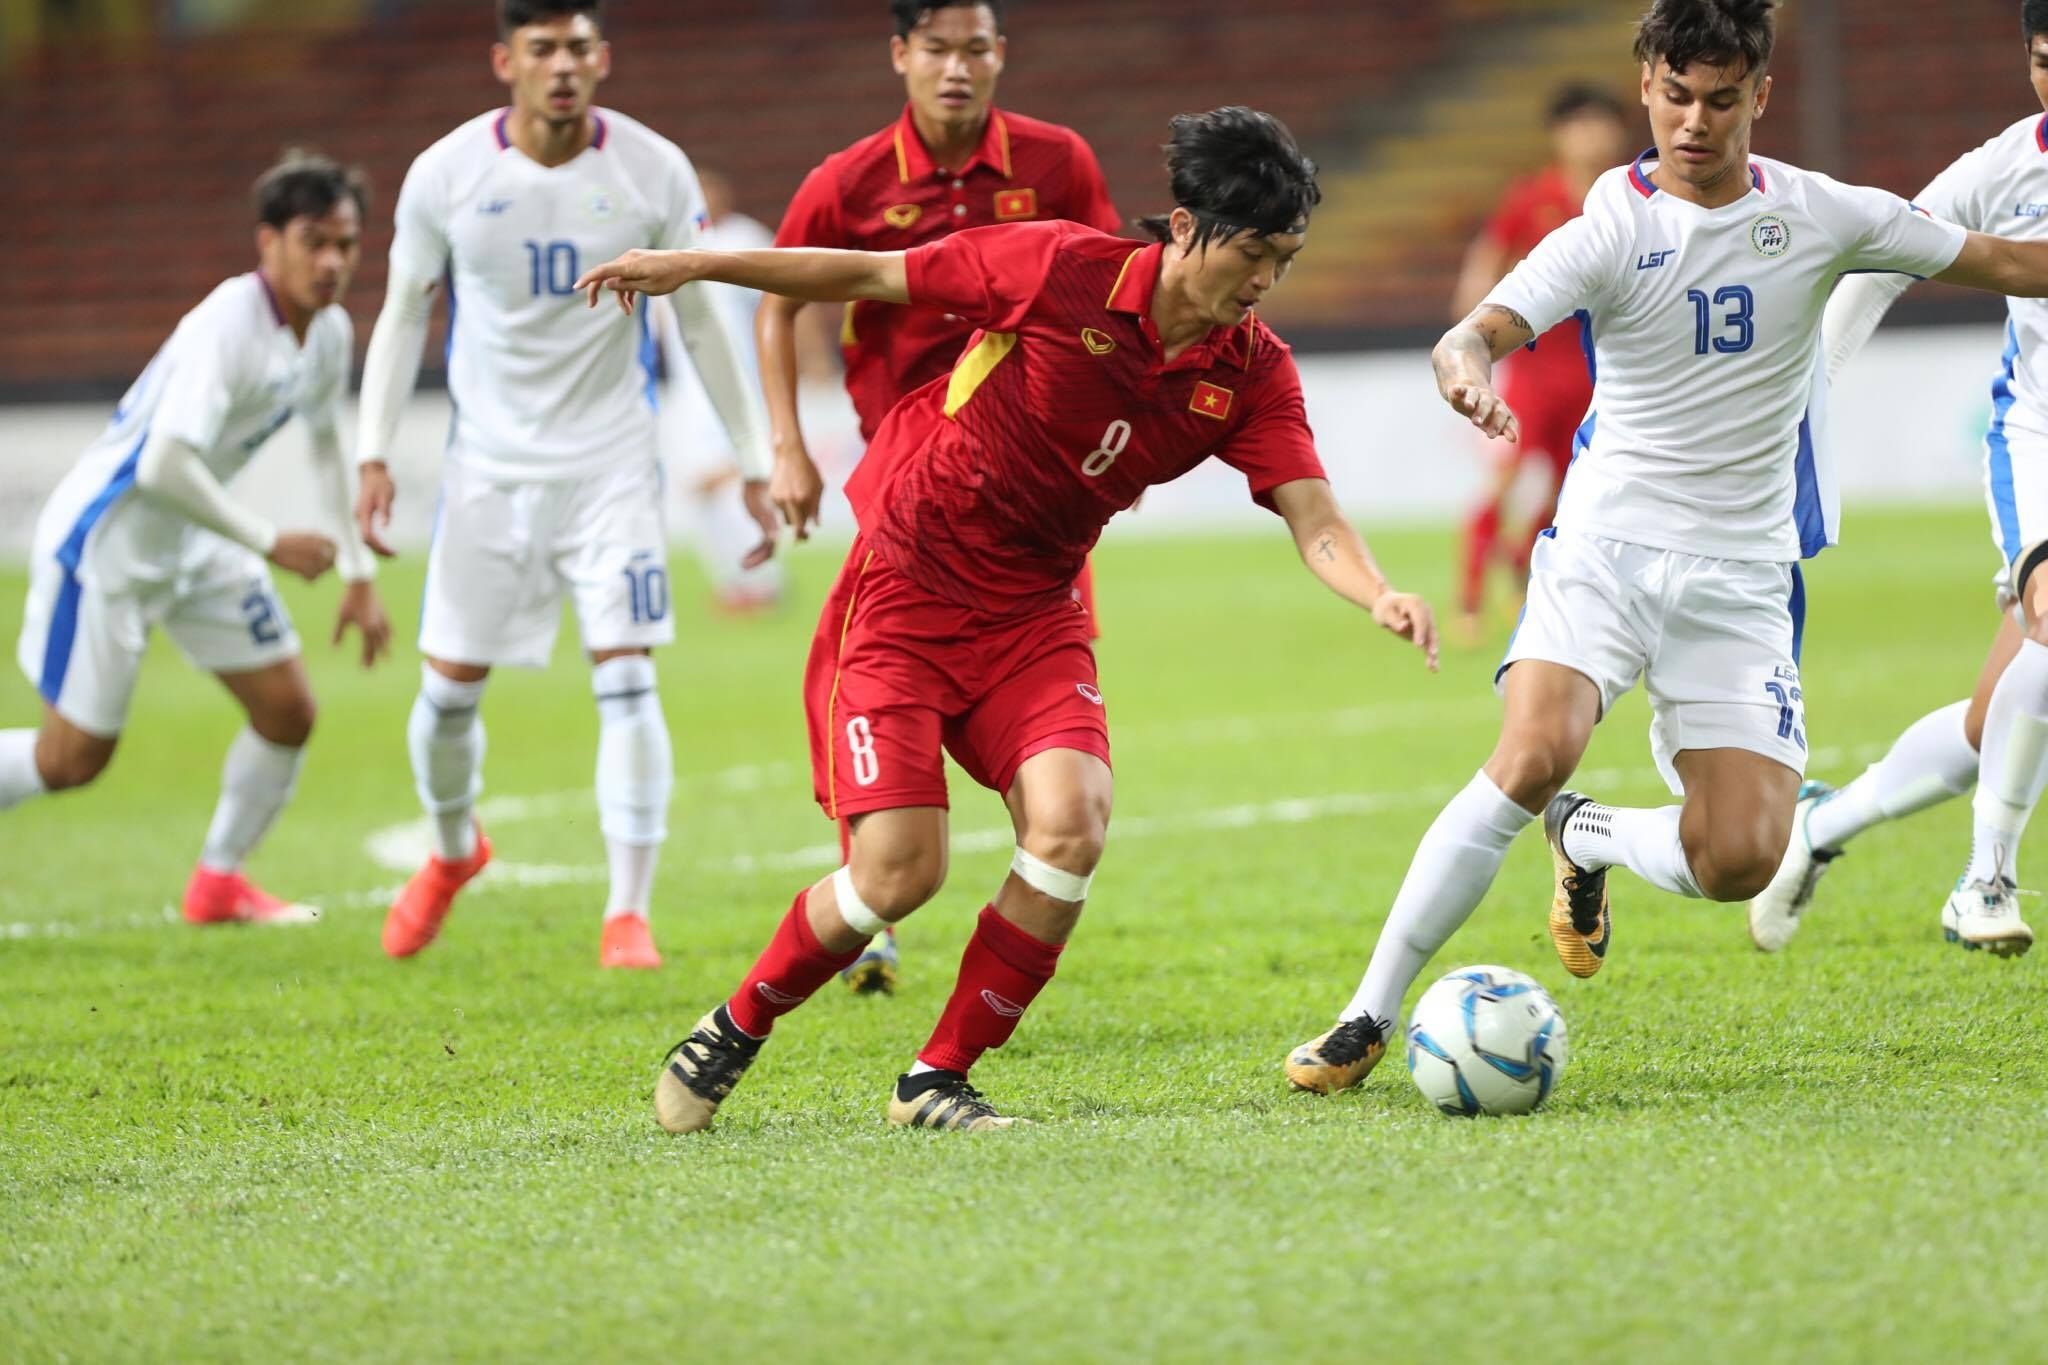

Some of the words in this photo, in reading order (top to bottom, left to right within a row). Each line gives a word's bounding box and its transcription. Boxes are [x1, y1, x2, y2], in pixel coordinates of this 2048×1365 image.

[523, 238, 579, 297] 10
[1762, 237, 1782, 247] PFF
[1687, 285, 1754, 356] 13
[1081, 419, 1131, 477] 8
[622, 568, 668, 623] 10
[846, 715, 880, 787] 8
